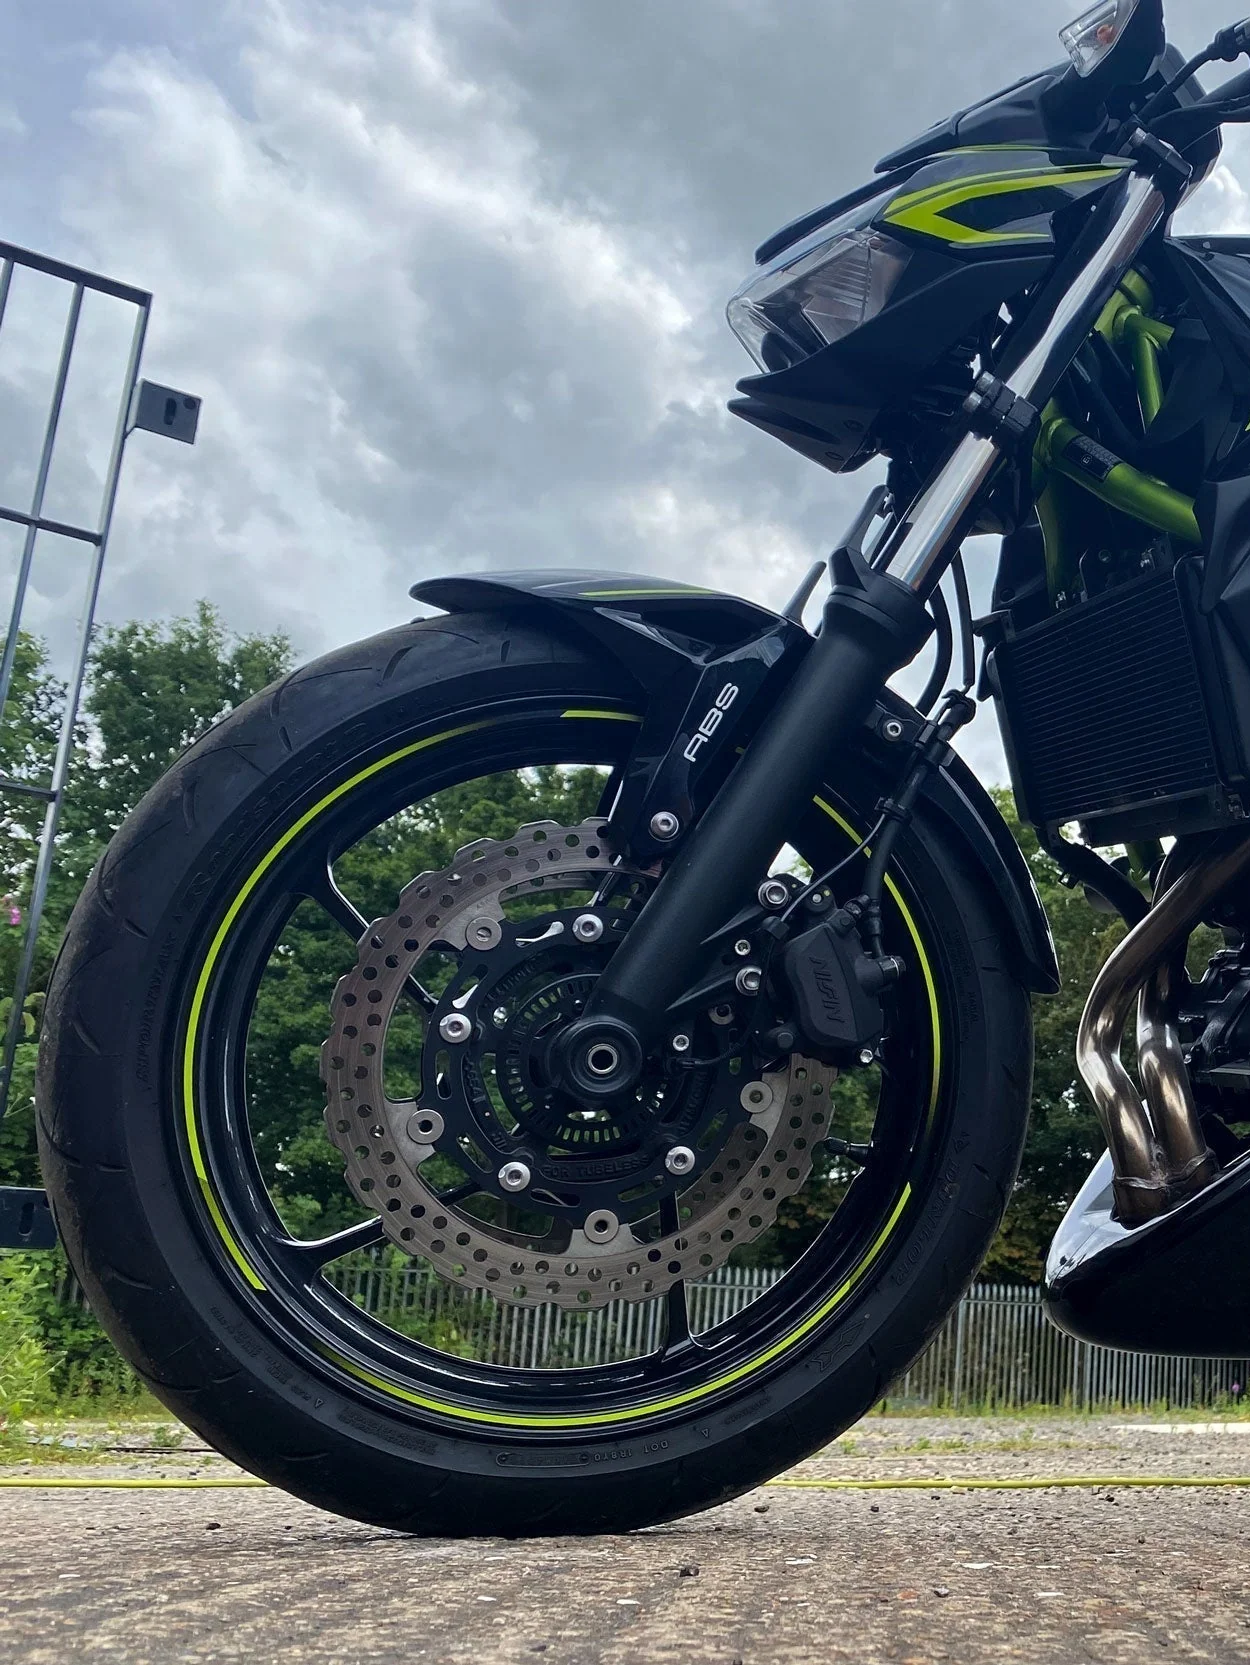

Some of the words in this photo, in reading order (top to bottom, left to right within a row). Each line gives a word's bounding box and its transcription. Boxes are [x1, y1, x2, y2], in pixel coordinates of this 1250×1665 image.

[684, 682, 739, 762] ABS
[807, 956, 846, 1023] NISSIN
[643, 1440, 669, 1453] DOT
